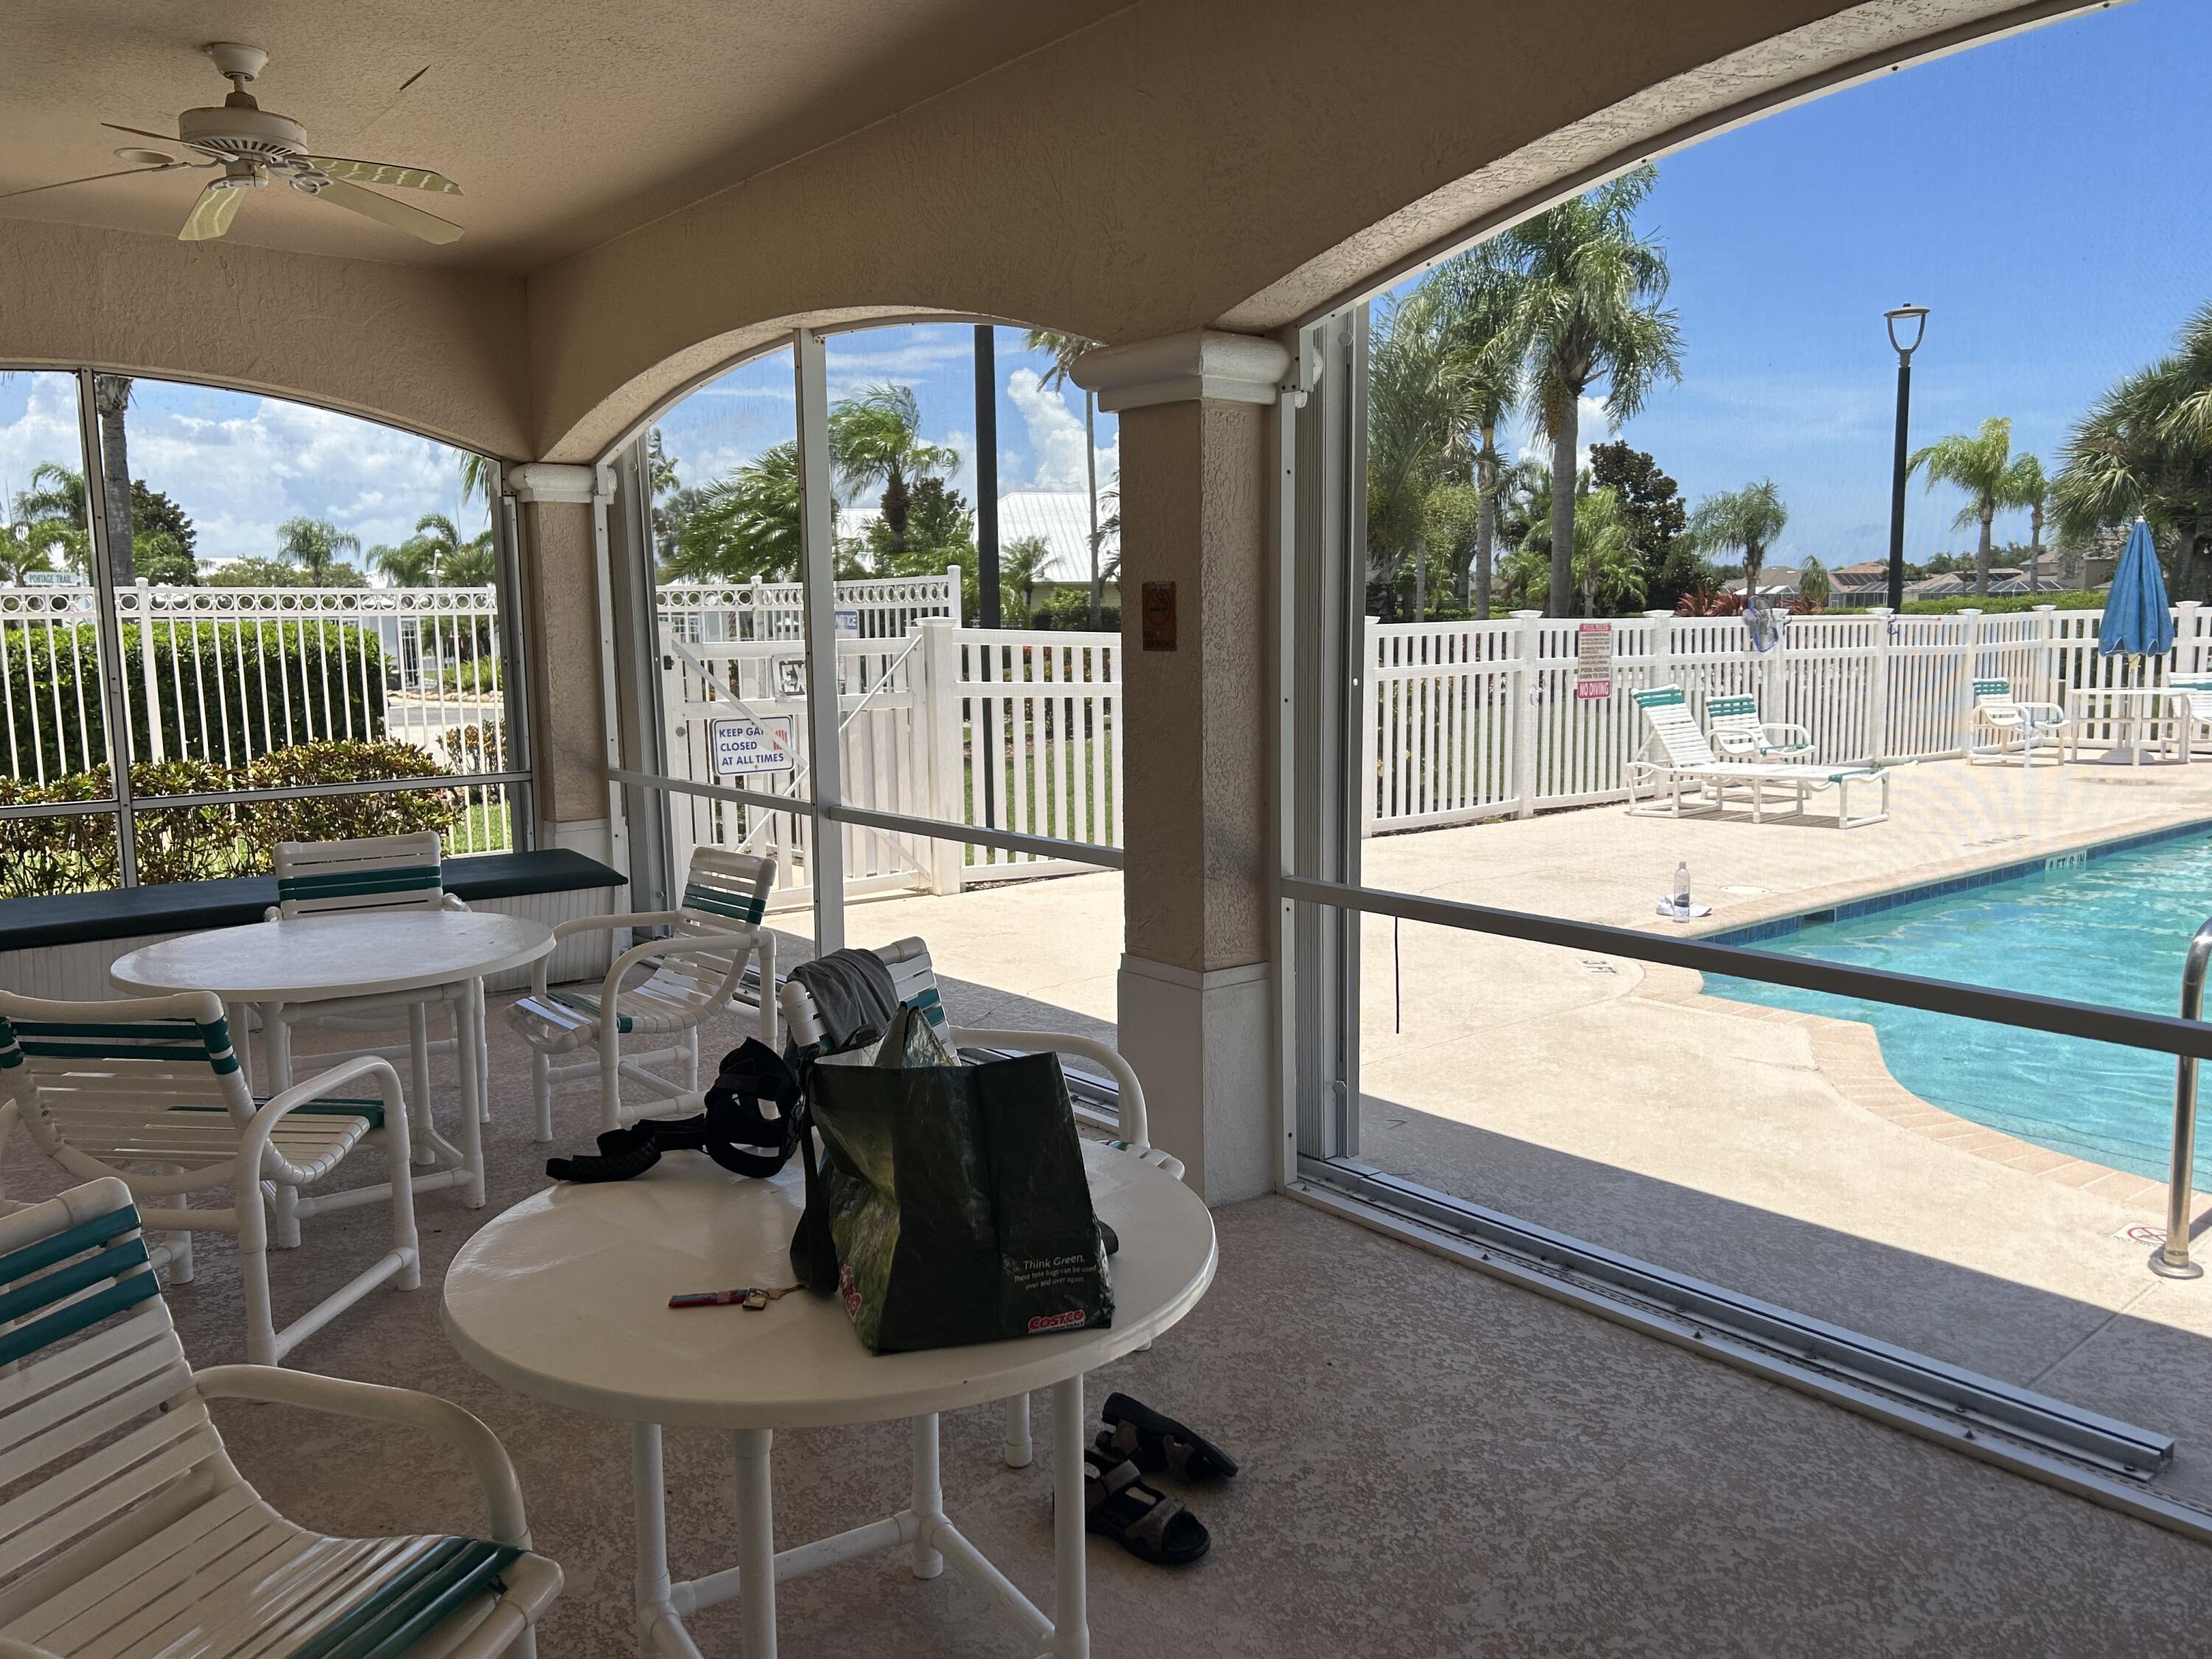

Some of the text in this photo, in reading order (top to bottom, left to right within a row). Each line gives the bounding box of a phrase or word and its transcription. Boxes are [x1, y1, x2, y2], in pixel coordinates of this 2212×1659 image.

[29, 574, 72, 583] PORTAGE TRAIL
[782, 663, 807, 692] EX
[1580, 682, 1608, 696] NO DIVING
[719, 727, 763, 737] KEEP GA
[720, 741, 757, 751] CLOSED
[722, 753, 784, 765] AT ALL TIMES
[1023, 1254, 1085, 1270] Think Green.
[1015, 1274, 1030, 1283] These
[1040, 1279, 1051, 1287] and
[1028, 1310, 1085, 1330] COSTCO
